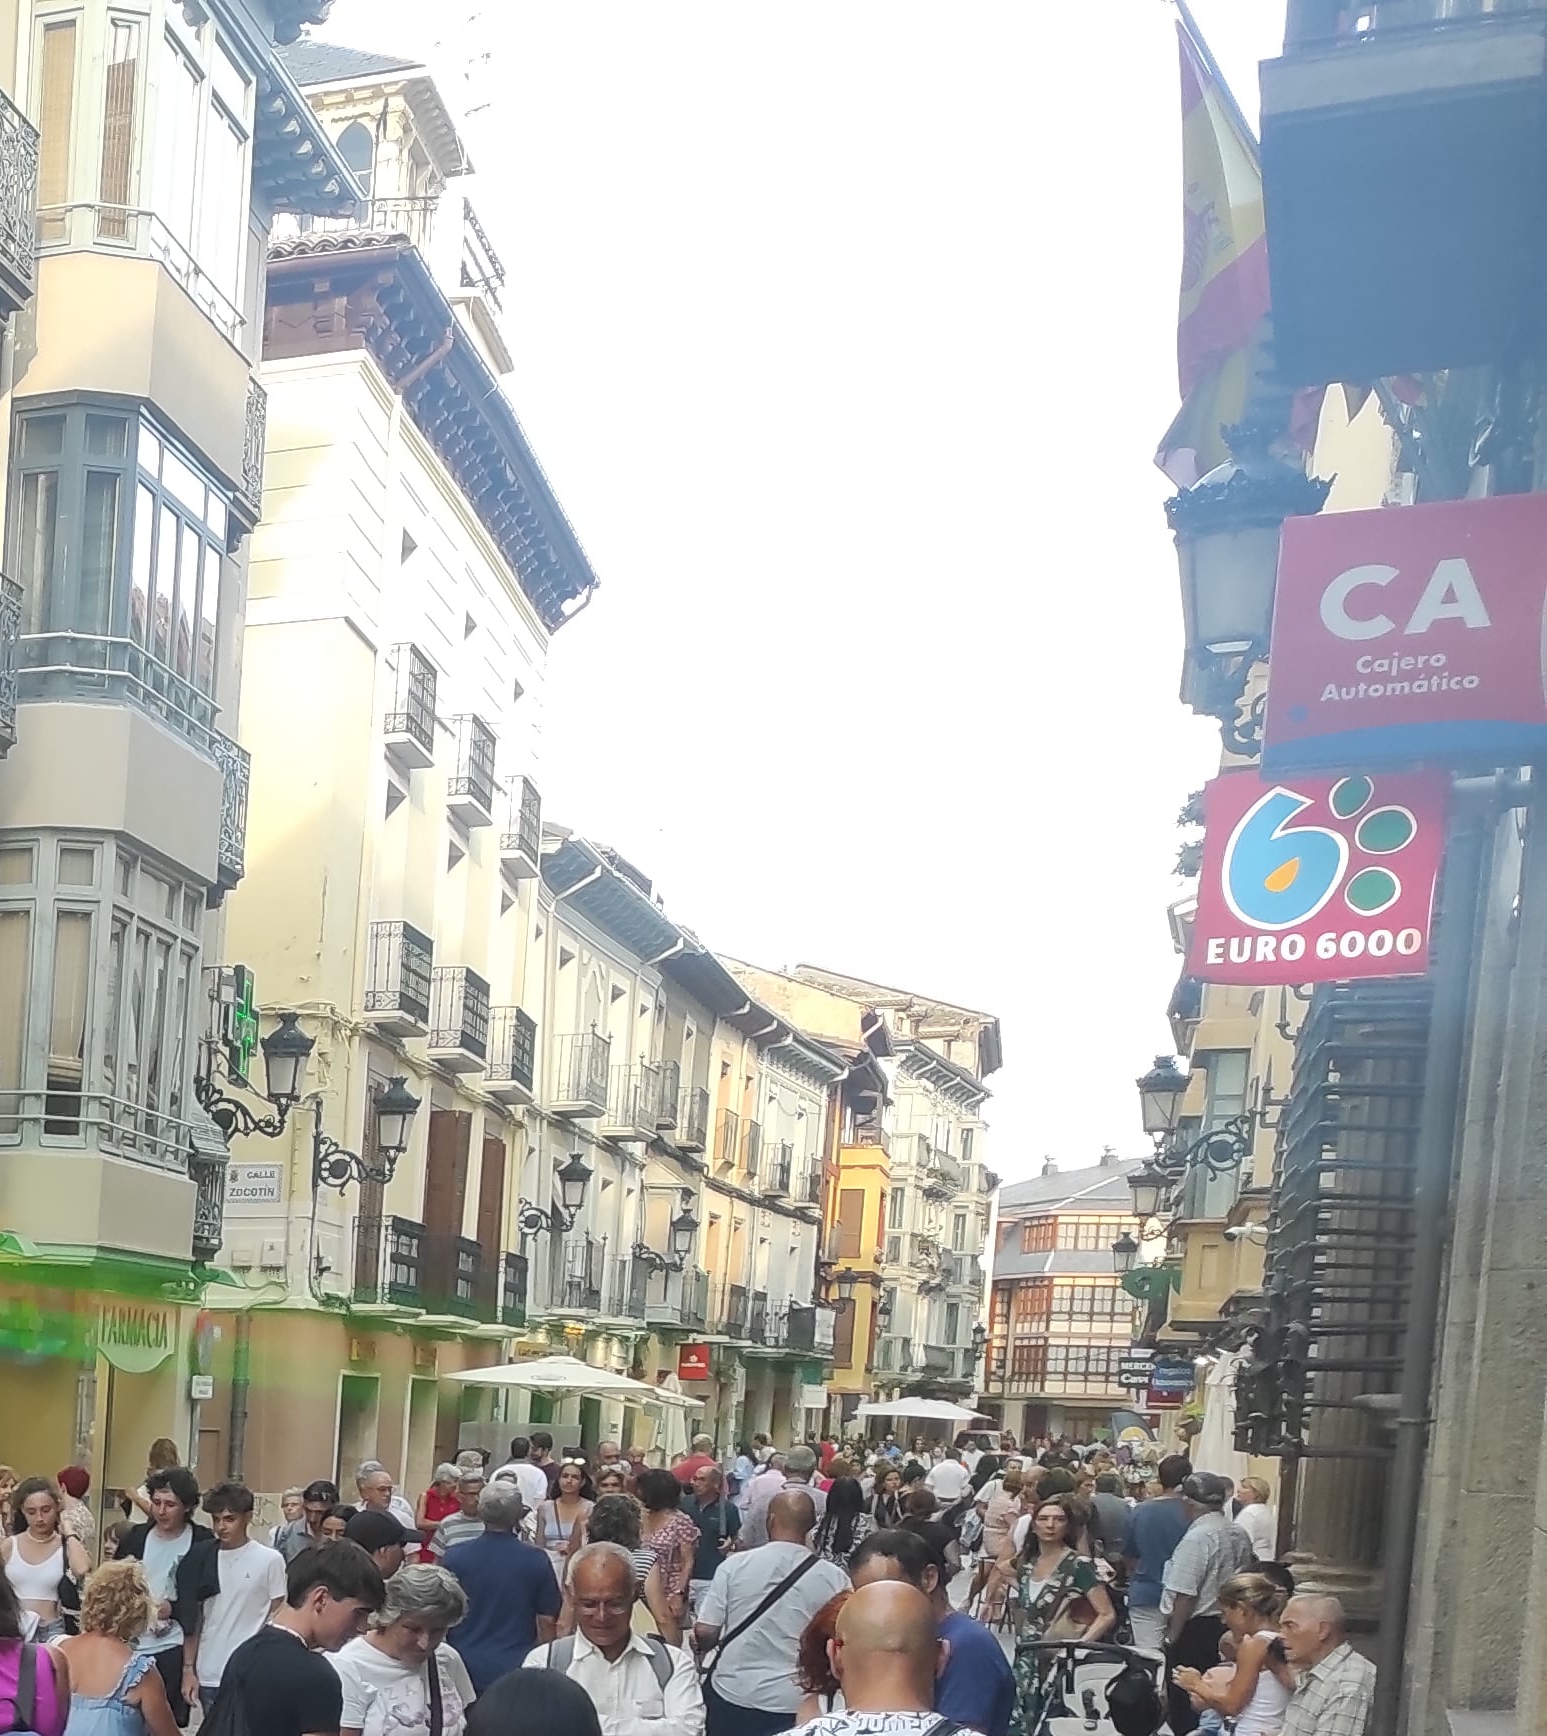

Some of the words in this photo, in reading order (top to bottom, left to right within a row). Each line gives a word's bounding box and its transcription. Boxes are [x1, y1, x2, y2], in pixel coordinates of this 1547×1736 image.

[1355, 651, 1447, 678] Cajero
[1320, 670, 1481, 702] Automático
[1205, 934, 1307, 965] EURO
[1315, 928, 1422, 960] 6000
[246, 1170, 276, 1179] CALLE
